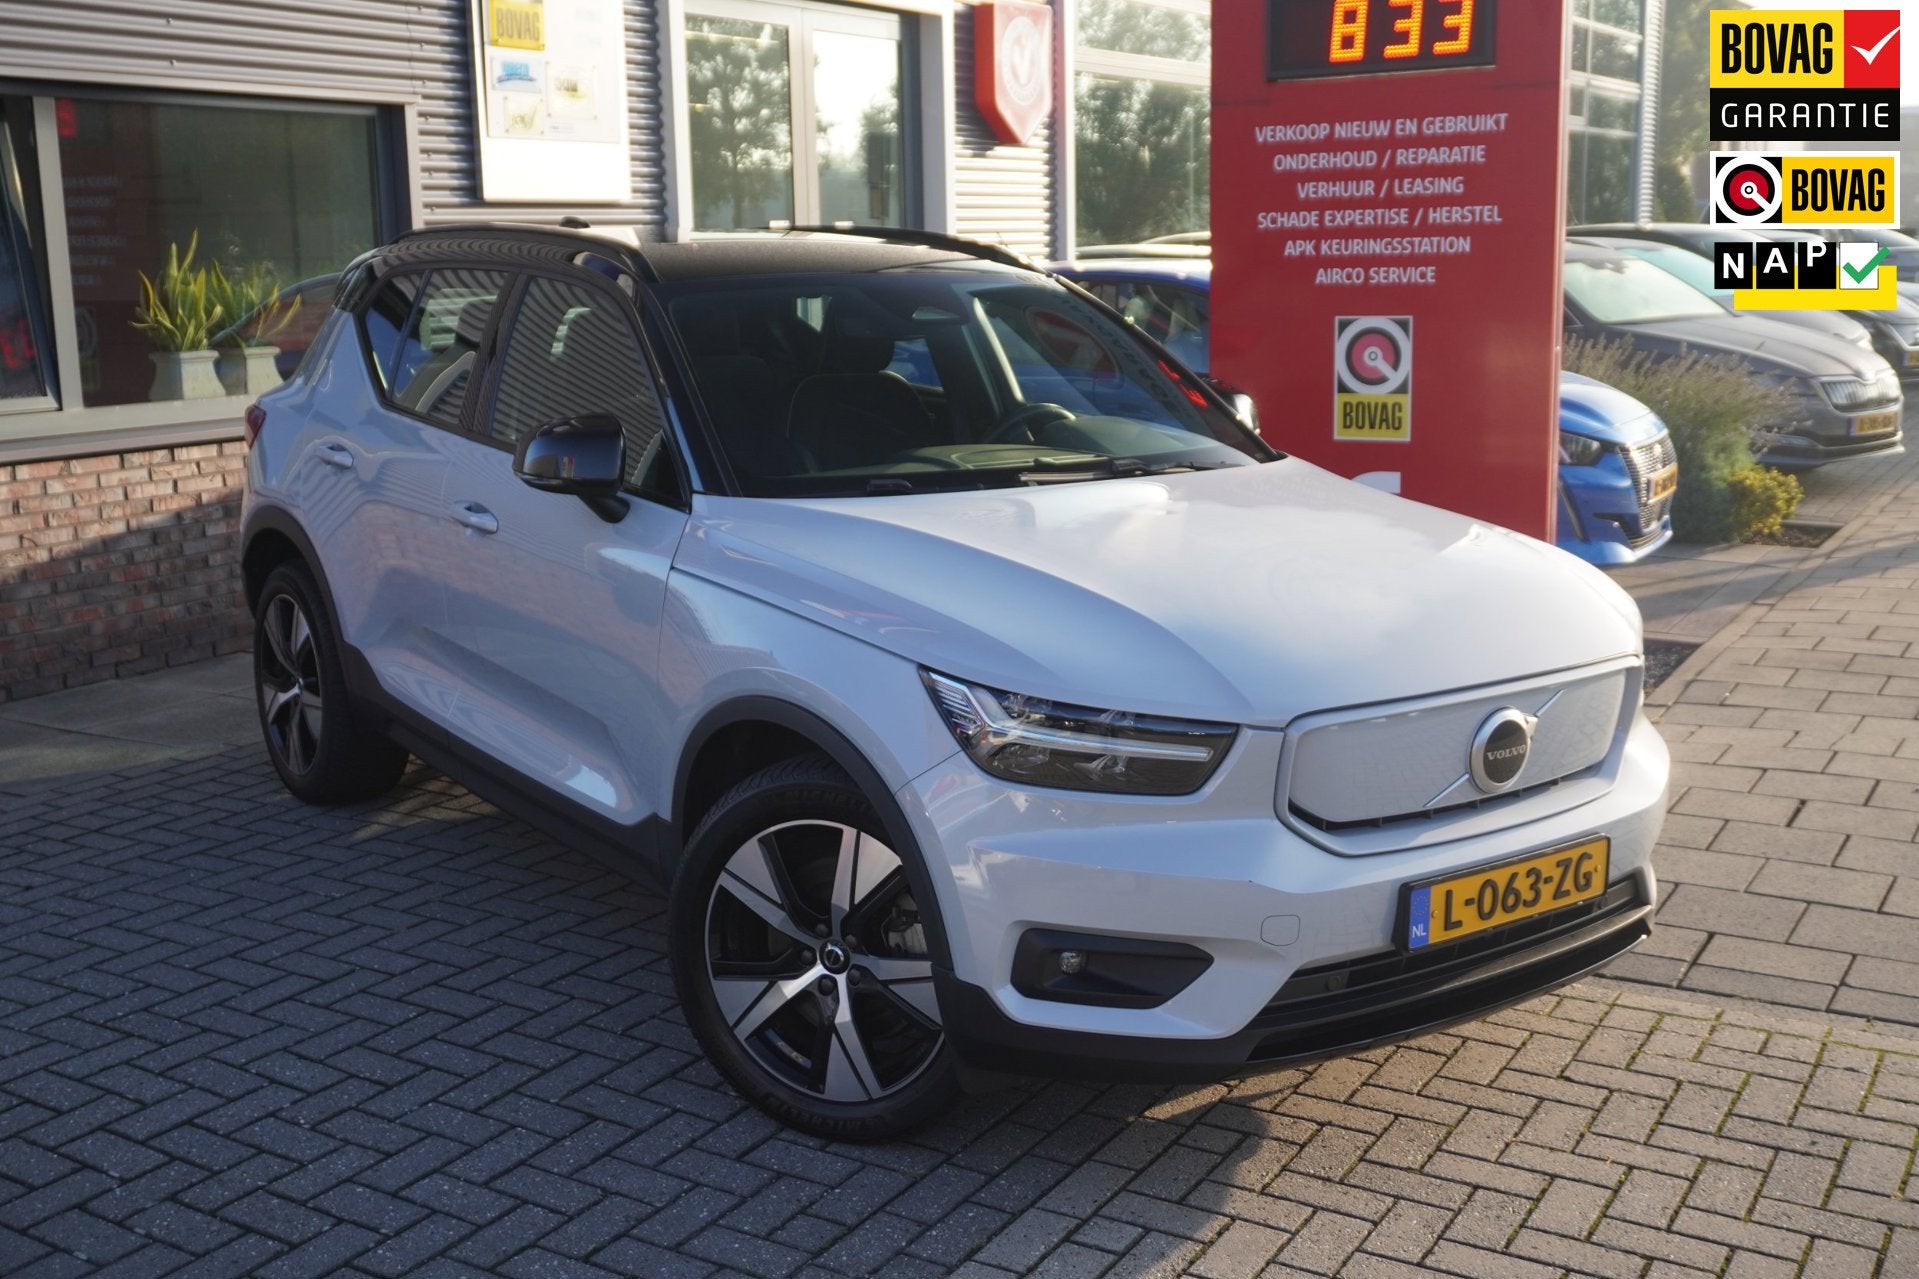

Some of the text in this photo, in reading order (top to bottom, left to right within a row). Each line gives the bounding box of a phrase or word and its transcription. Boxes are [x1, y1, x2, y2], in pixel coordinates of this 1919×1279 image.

[495, 8, 541, 42] BOVAG
[1328, 0, 1475, 63] 833
[1255, 113, 1509, 143] VERKOOP NIEUW EN GEBRUIKT
[1273, 149, 1378, 172] ONDERHOUD
[1396, 145, 1487, 166] REPARATIE
[1297, 178, 1375, 199] VERHUUR
[1394, 176, 1465, 196] LEASING
[1258, 211, 1320, 230] SCHADE
[1324, 208, 1409, 227] EXPERTISE
[1428, 205, 1503, 224] HERSTEL
[1284, 236, 1471, 256] APK KEURINGSSTATION
[1315, 266, 1436, 285] AIRCO SERVICE
[1342, 401, 1403, 430] BOVAG
[1486, 744, 1526, 761] VOLVO
[1411, 852, 1594, 938] NL L-063-ZG
